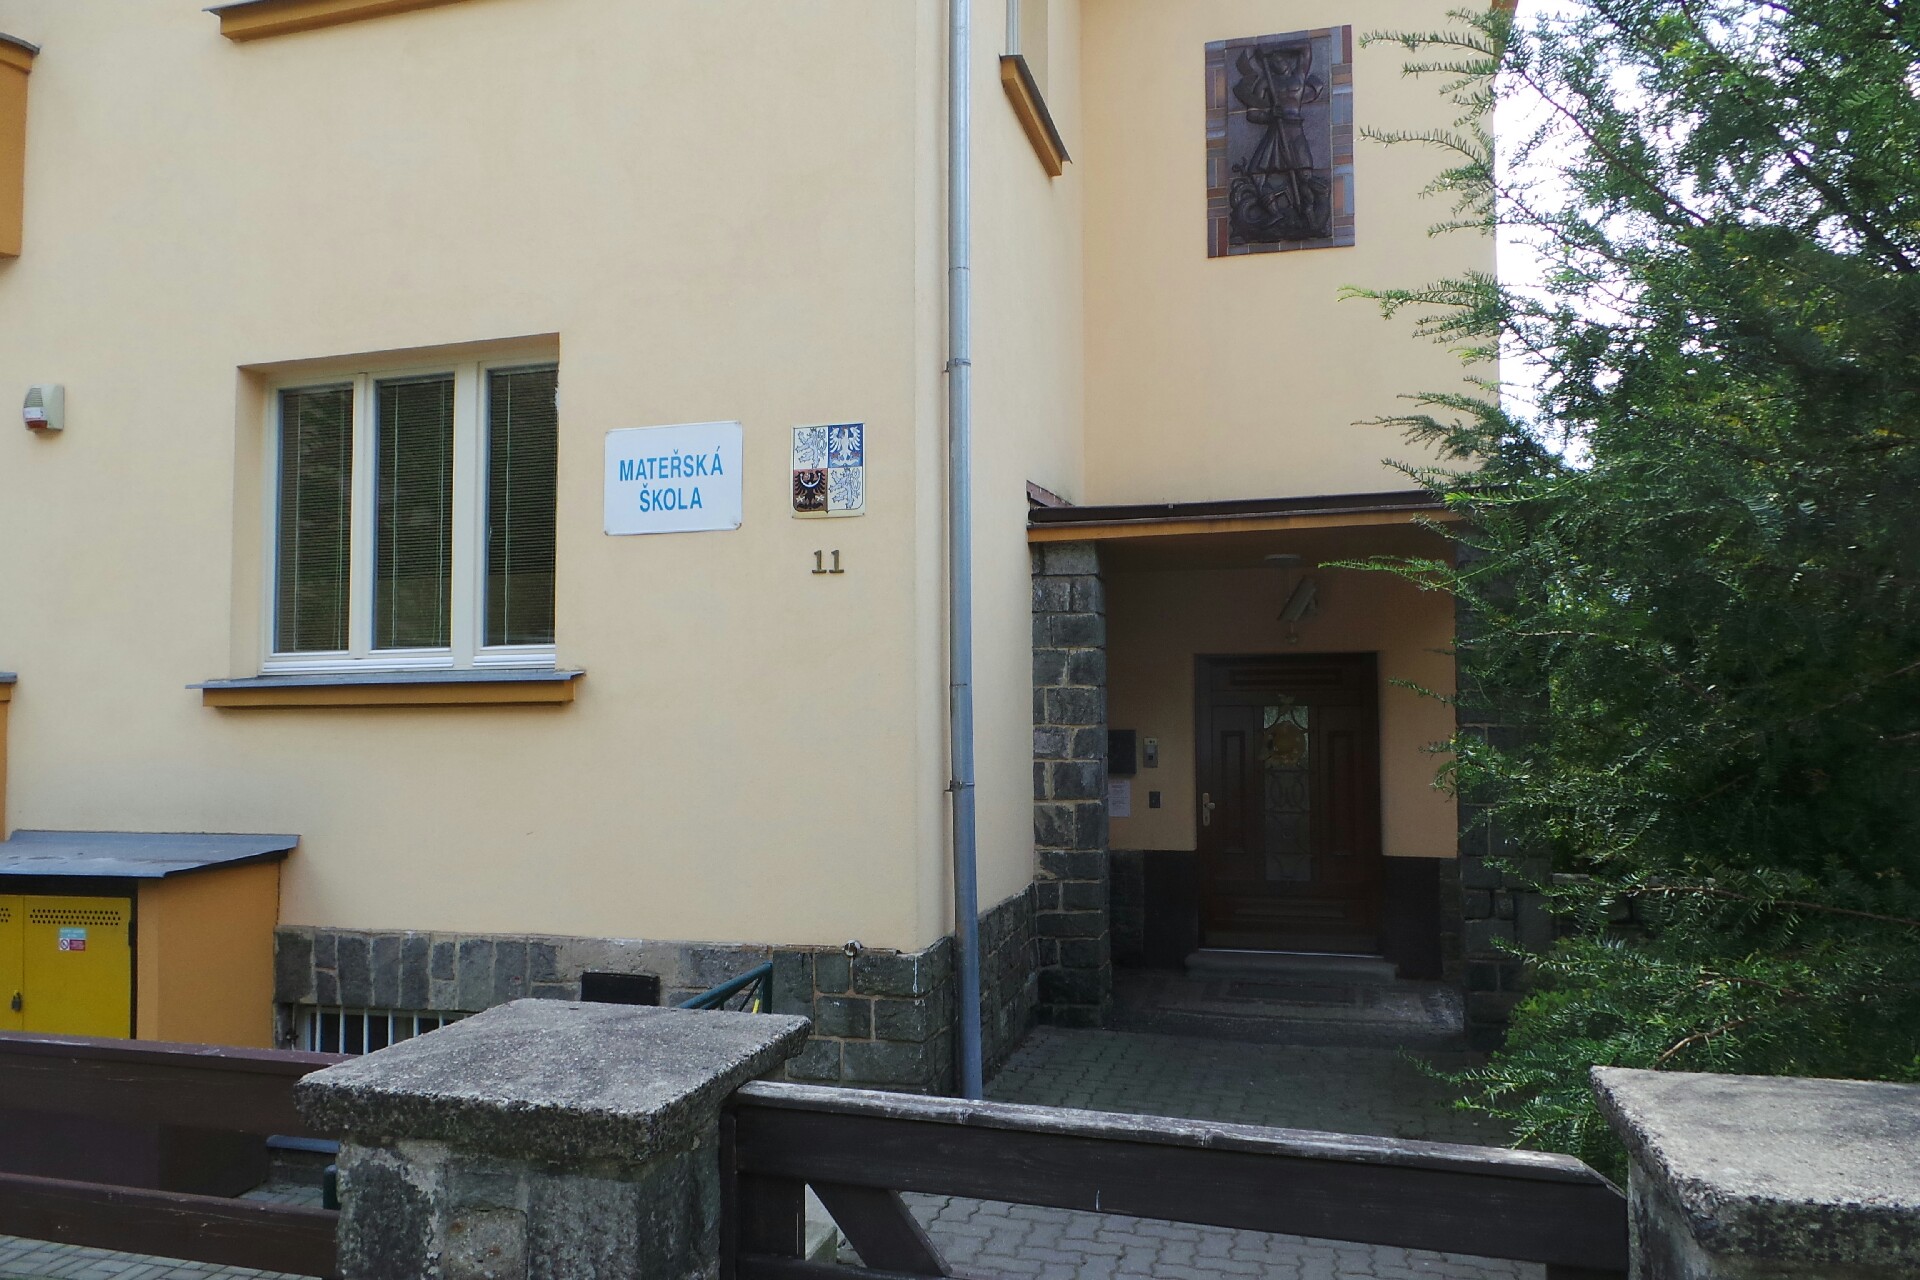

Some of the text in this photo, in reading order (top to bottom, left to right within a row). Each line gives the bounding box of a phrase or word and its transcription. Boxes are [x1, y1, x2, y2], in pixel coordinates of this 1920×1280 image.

[619, 446, 723, 481] MATEŘSKÁ
[639, 482, 703, 512] ŠKOLA
[811, 549, 844, 574] 11
